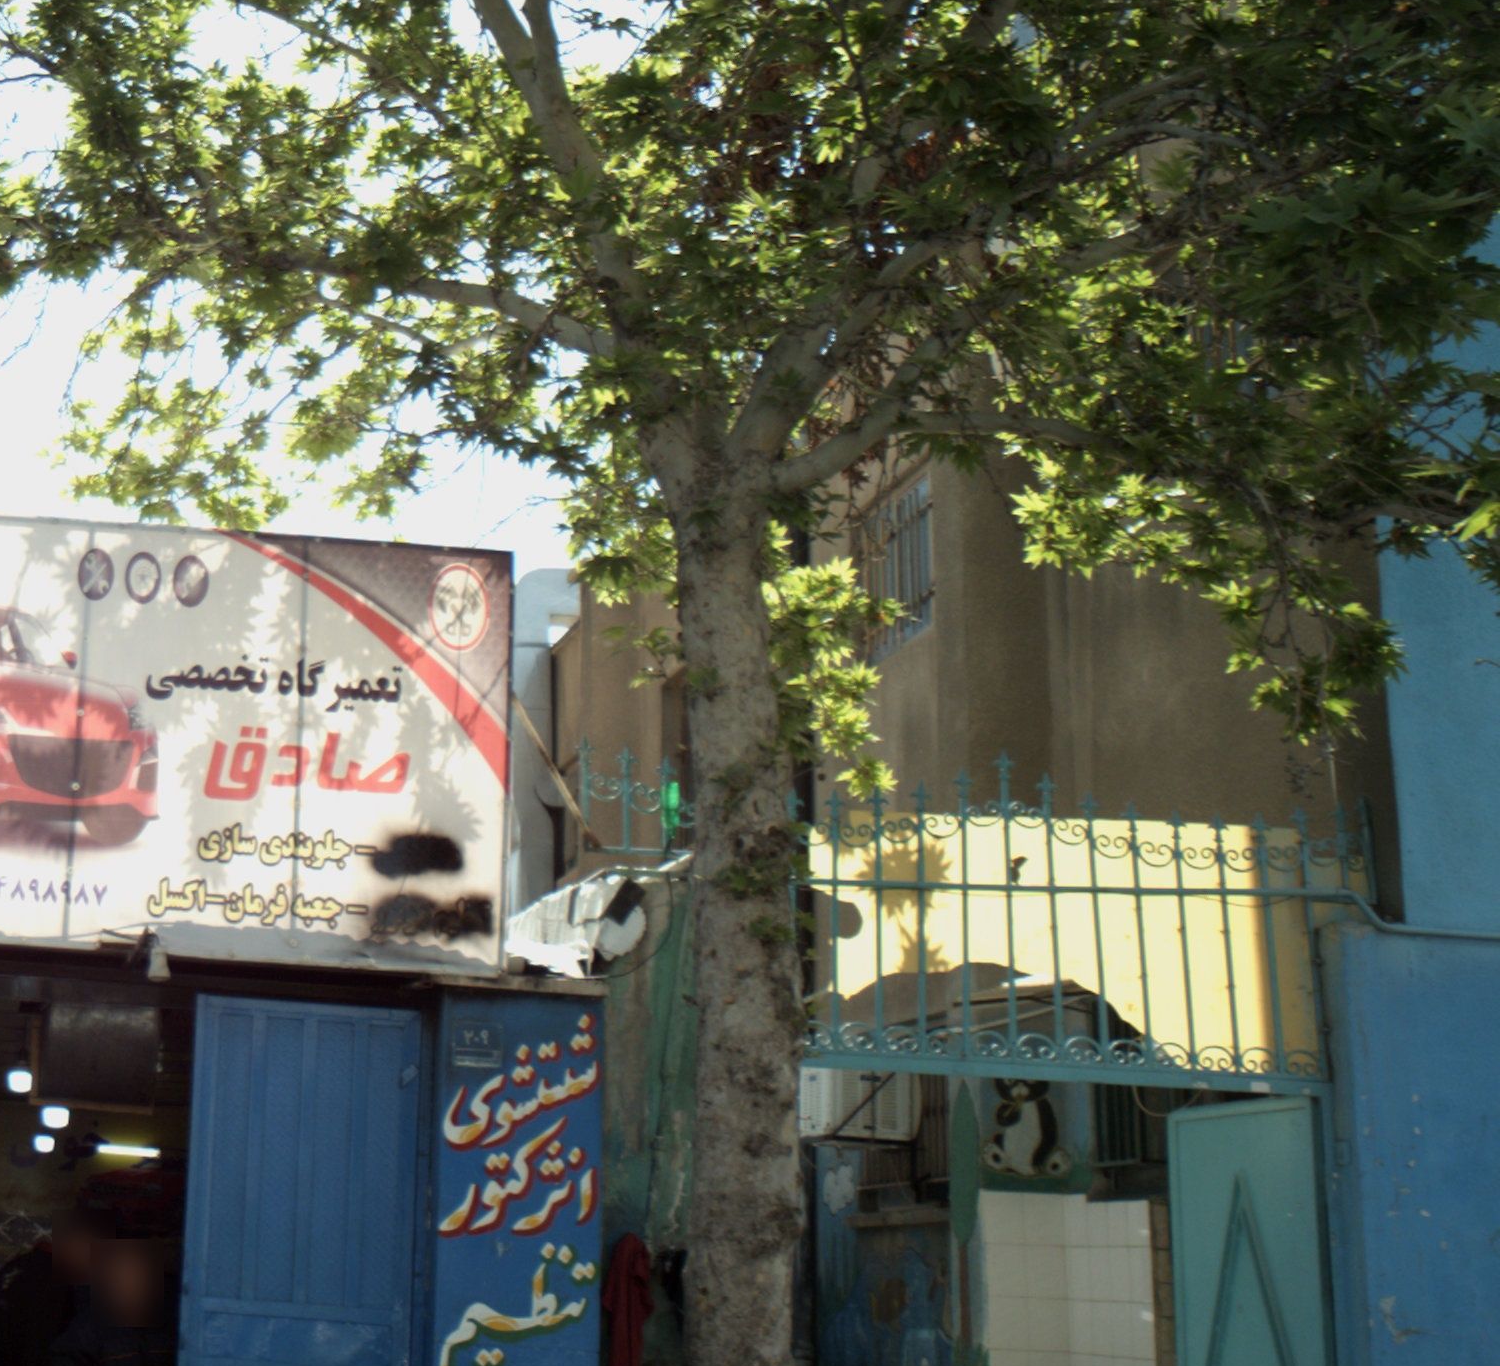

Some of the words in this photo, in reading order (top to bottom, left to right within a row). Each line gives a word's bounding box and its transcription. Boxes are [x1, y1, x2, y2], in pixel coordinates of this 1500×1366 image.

[146, 654, 269, 700] تخصصی
[204, 726, 411, 801] صادق
[198, 822, 257, 863] سازی
[259, 829, 352, 870] جلوبندی
[291, 893, 344, 929] جعبه
[443, 1014, 598, 1149] شستشوی
[438, 1116, 597, 1235] انژکتور
